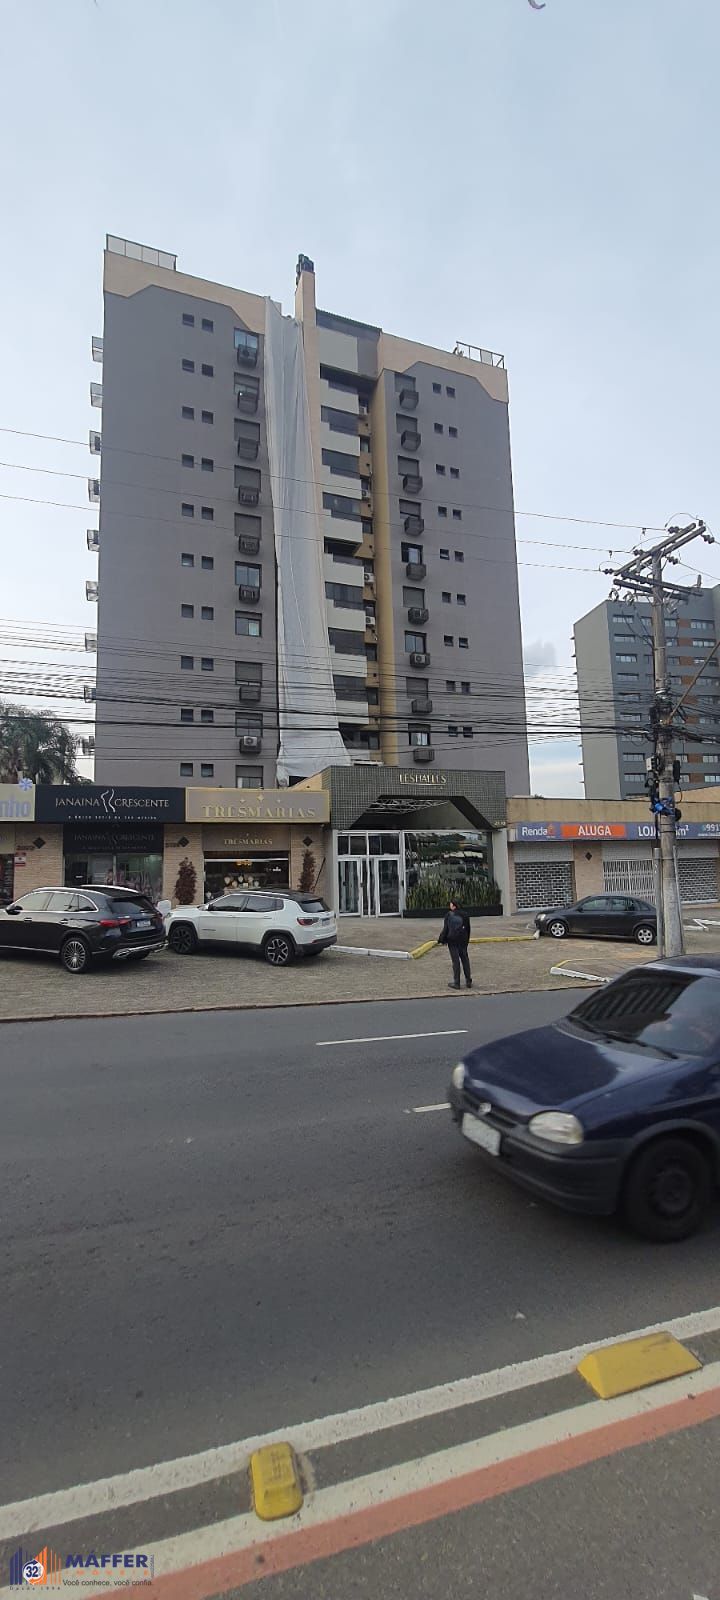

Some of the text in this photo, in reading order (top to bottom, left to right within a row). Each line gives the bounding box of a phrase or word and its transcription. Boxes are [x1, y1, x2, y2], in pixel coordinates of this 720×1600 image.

[55, 797, 170, 808] JANAINA CRESCENTE
[578, 826, 612, 836] ALUGA
